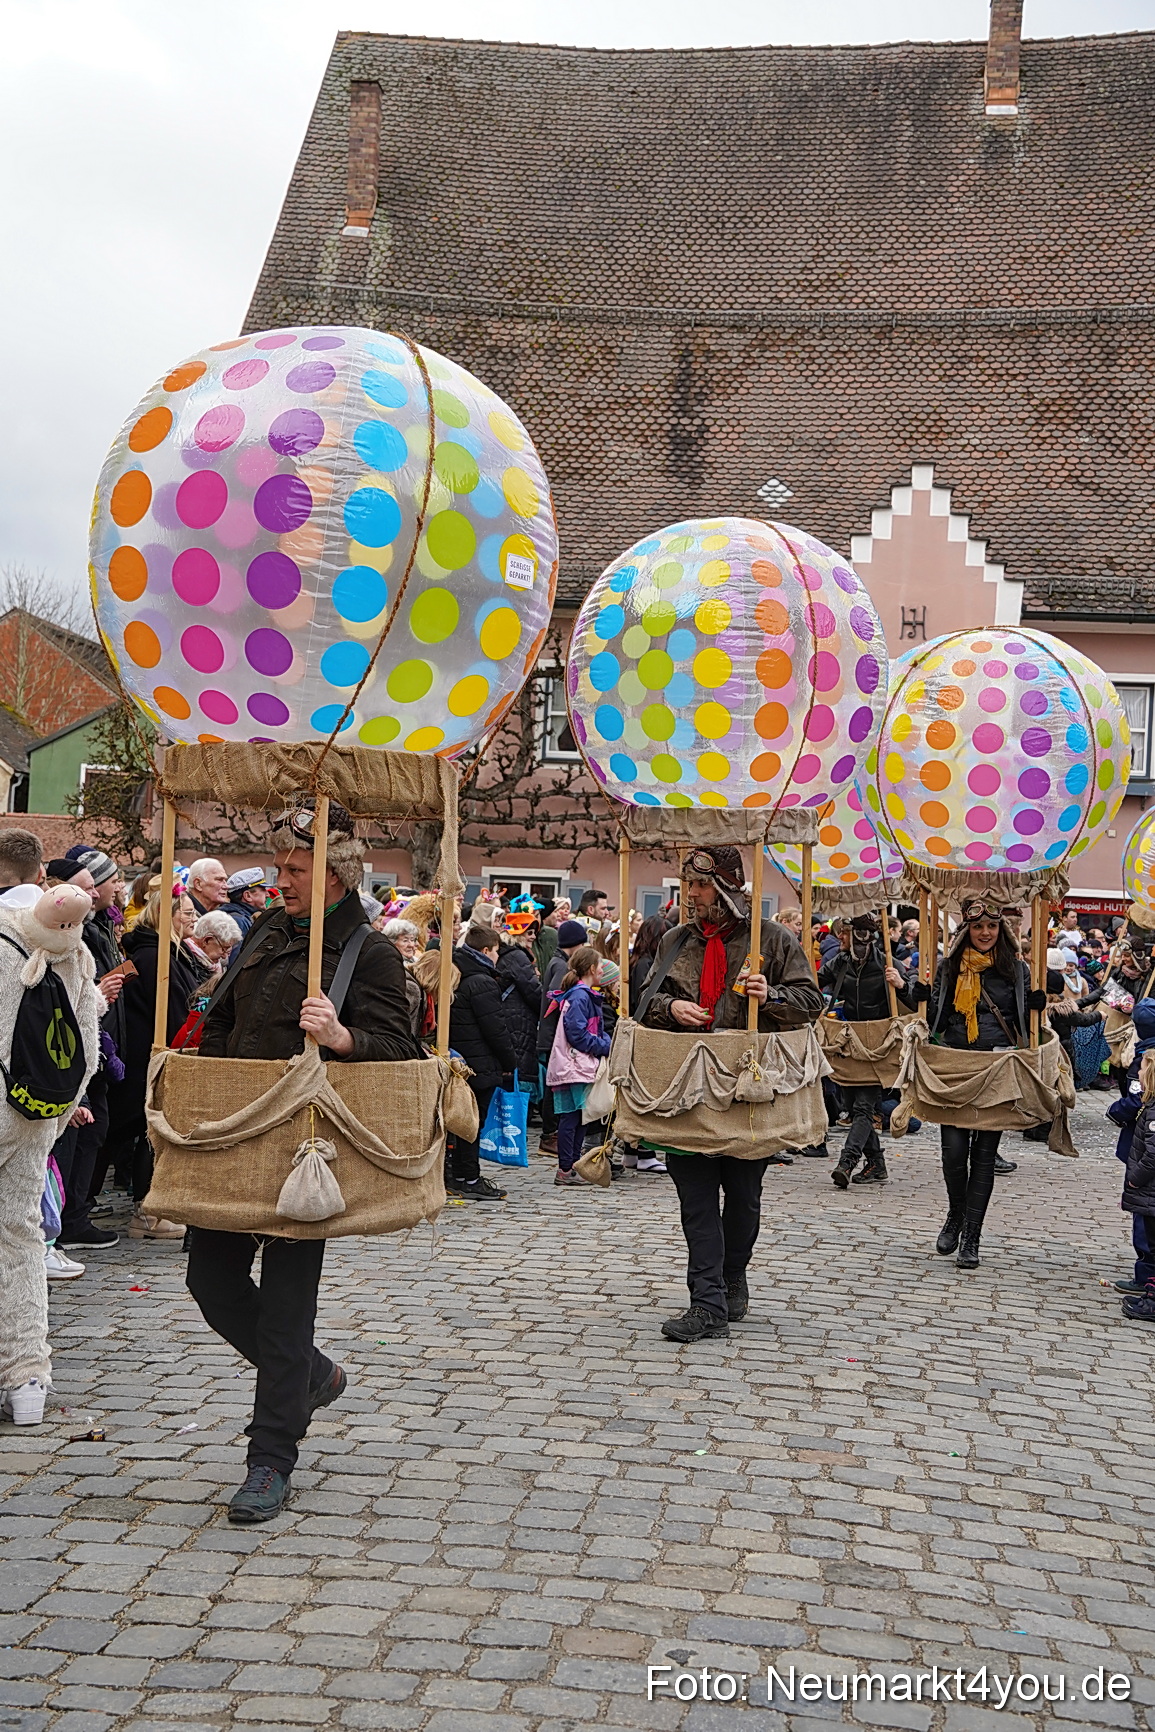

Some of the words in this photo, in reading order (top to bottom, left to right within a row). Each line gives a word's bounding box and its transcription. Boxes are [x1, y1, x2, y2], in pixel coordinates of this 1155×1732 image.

[510, 561, 531, 572] SCHEISSE
[509, 571, 531, 582] GEPARKT!
[1104, 903, 1132, 912] HUTT
